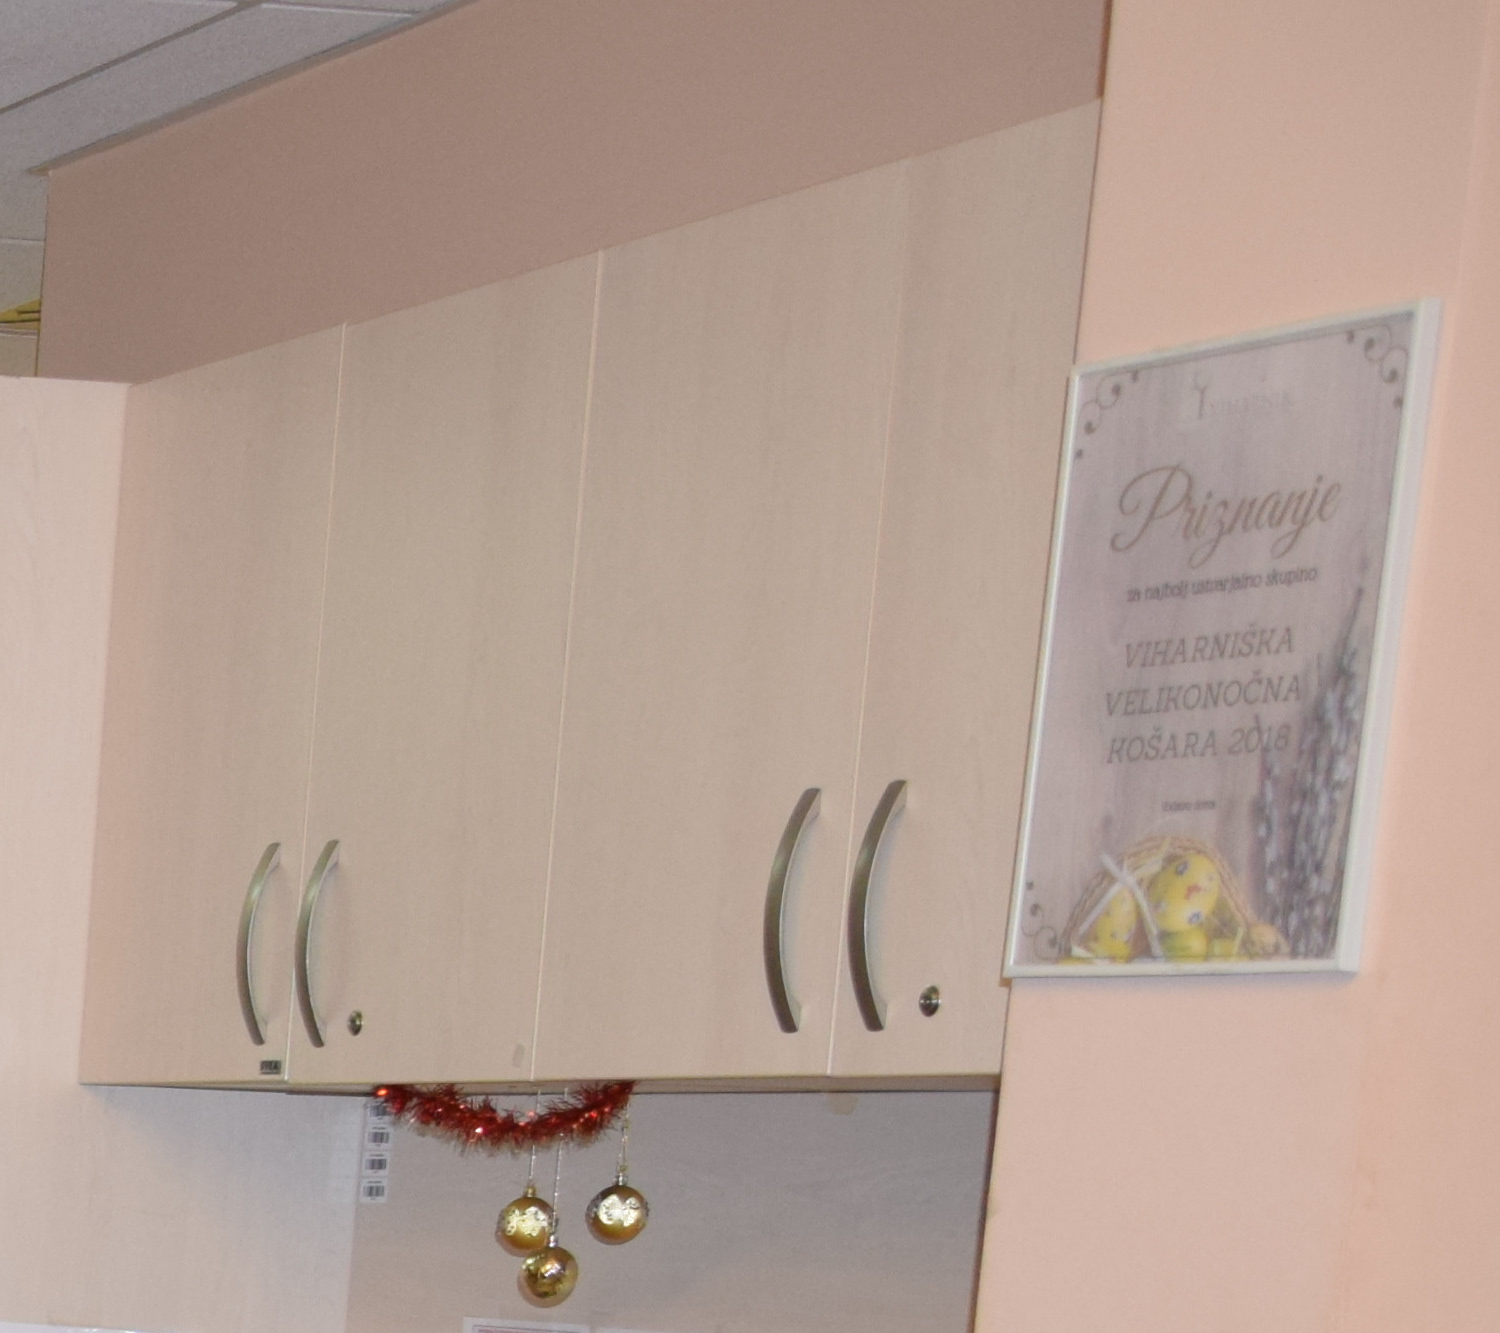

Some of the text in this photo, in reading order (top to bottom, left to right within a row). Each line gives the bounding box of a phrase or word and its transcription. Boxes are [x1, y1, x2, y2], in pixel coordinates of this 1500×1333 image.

[1109, 463, 1342, 569] Priznanje
[1264, 566, 1319, 587] skupino
[1125, 621, 1293, 669] VIHARNIŠKA
[1104, 669, 1300, 717] VELIKONOČNA
[1106, 722, 1292, 764] KOŠARA 2018
